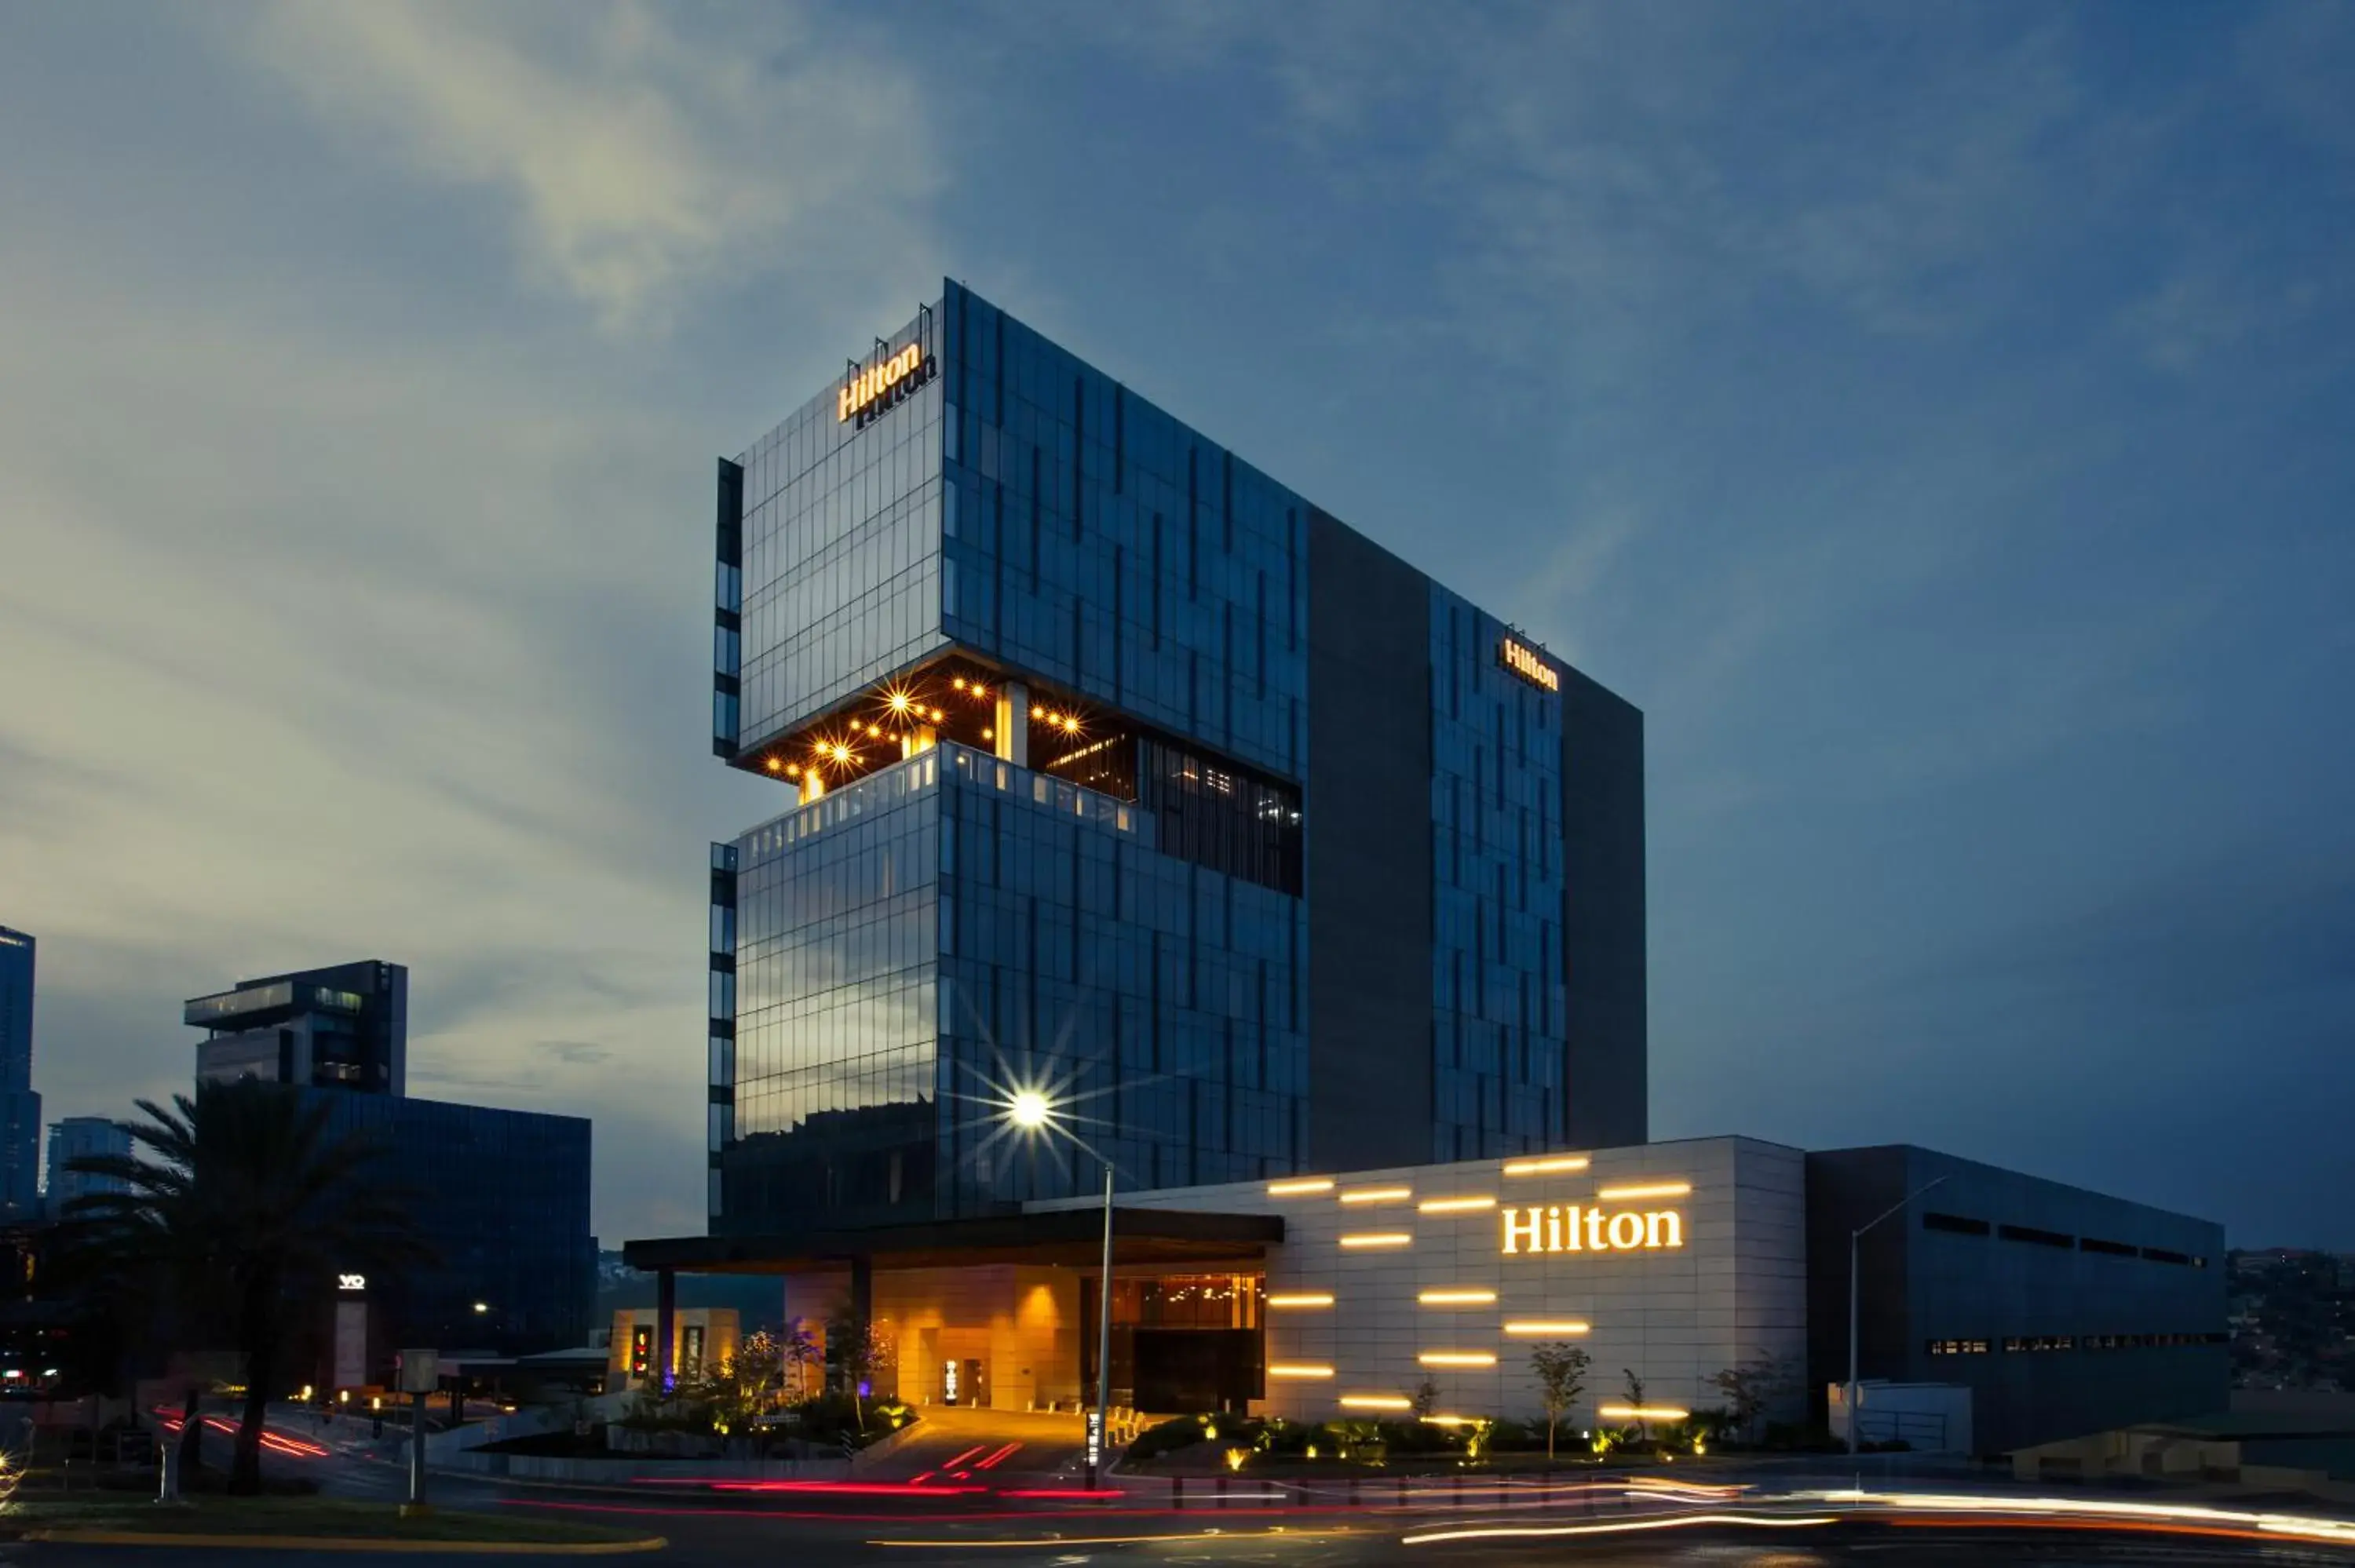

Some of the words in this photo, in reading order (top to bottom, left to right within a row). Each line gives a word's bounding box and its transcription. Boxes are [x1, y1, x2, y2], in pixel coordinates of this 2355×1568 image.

[838, 343, 920, 424] Hilton
[1505, 638, 1558, 691] Hilton
[1502, 1206, 1683, 1253] Hilton
